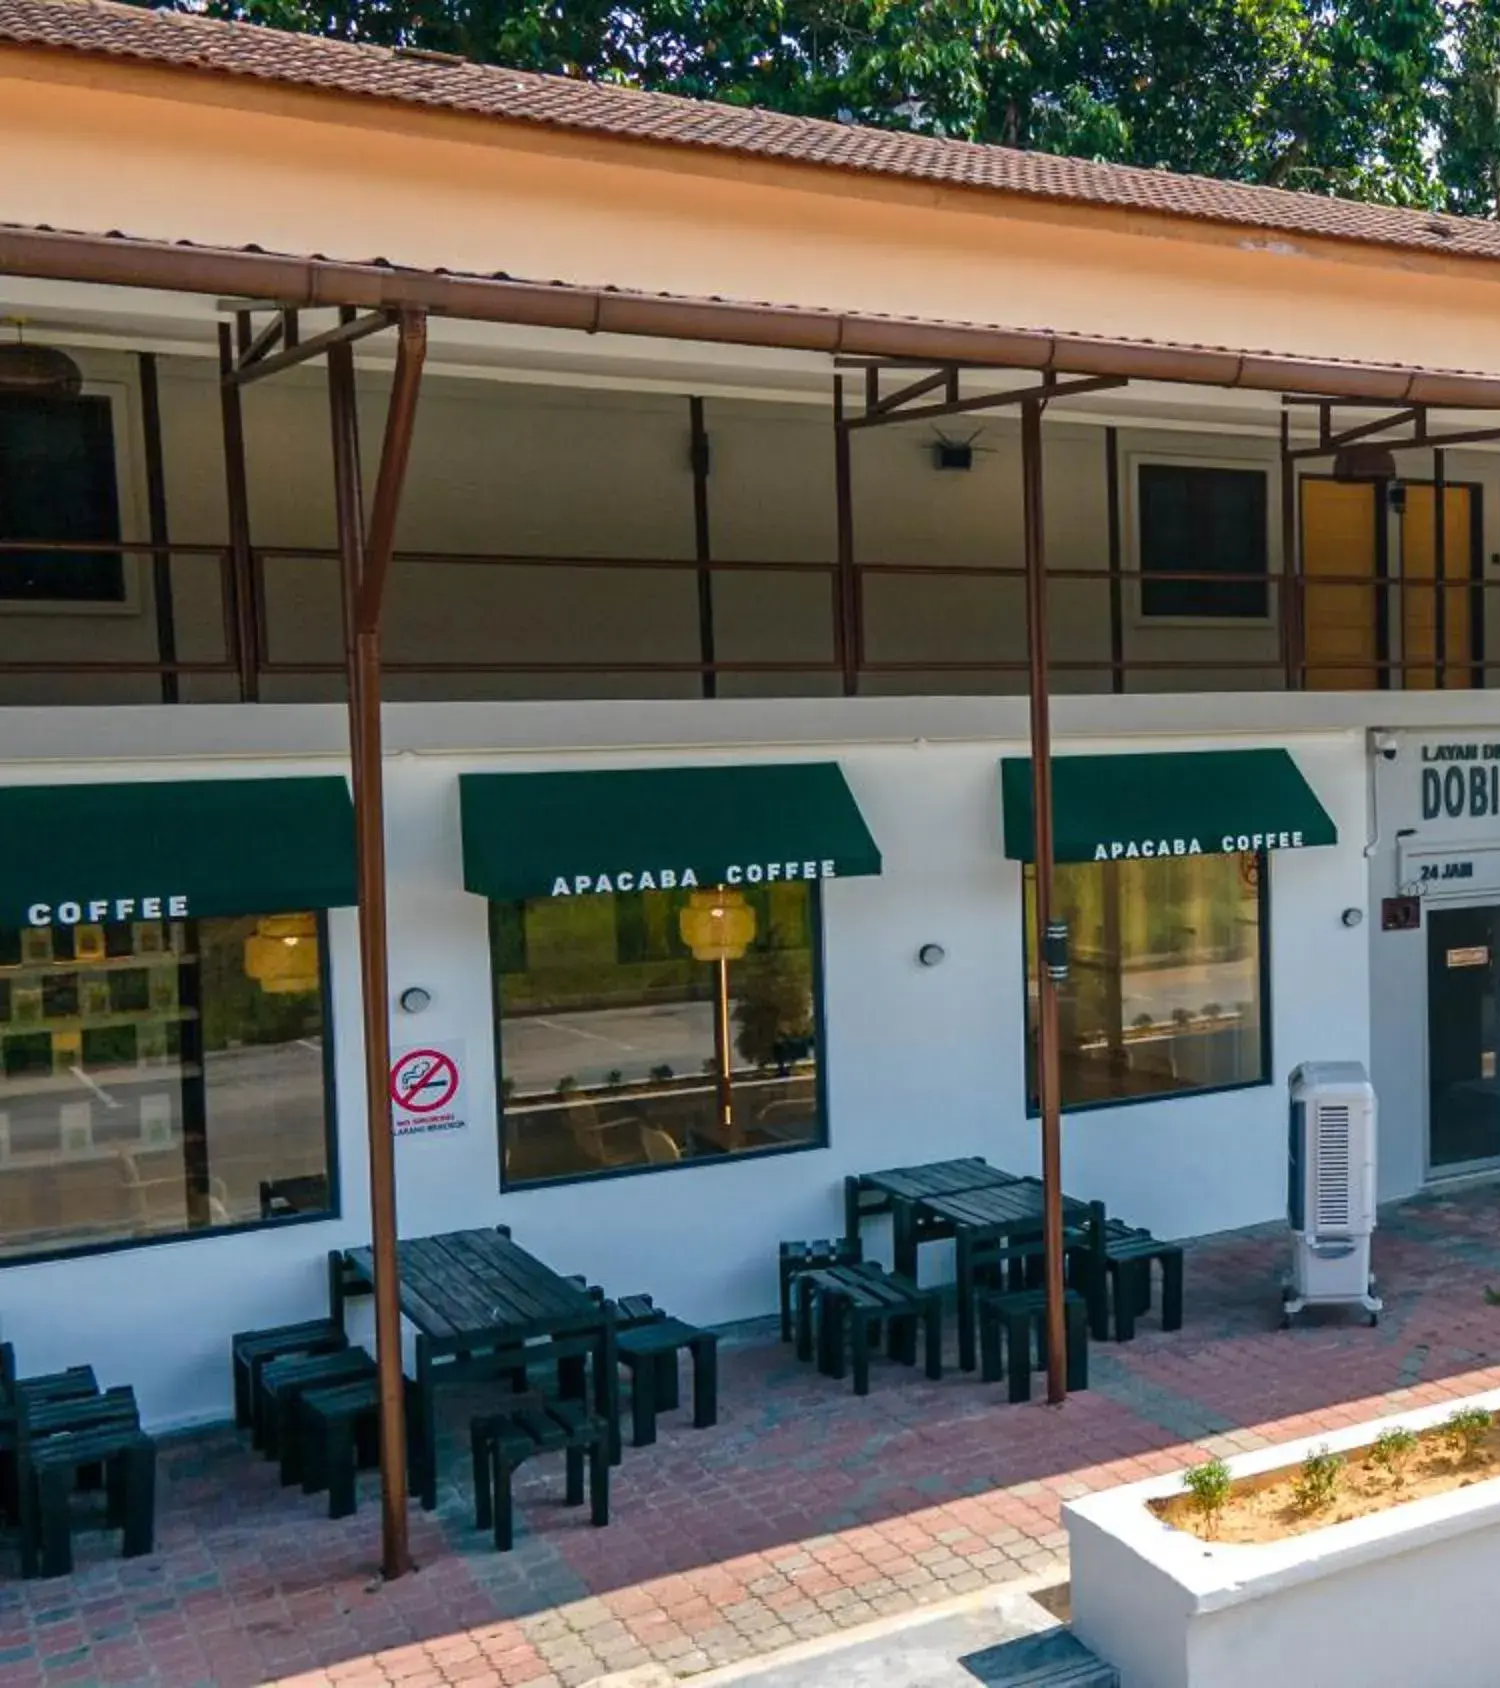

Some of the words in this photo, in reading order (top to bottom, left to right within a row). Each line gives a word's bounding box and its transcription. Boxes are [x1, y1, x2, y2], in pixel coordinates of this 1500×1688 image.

[1422, 765, 1498, 820] DOBI
[1095, 838, 1202, 861] APACABA
[1221, 831, 1303, 851] COFFEE
[552, 868, 699, 896] APACABA
[726, 859, 836, 884] COFFEE
[1420, 865, 1438, 880] 24
[28, 895, 189, 926] COFFEE
